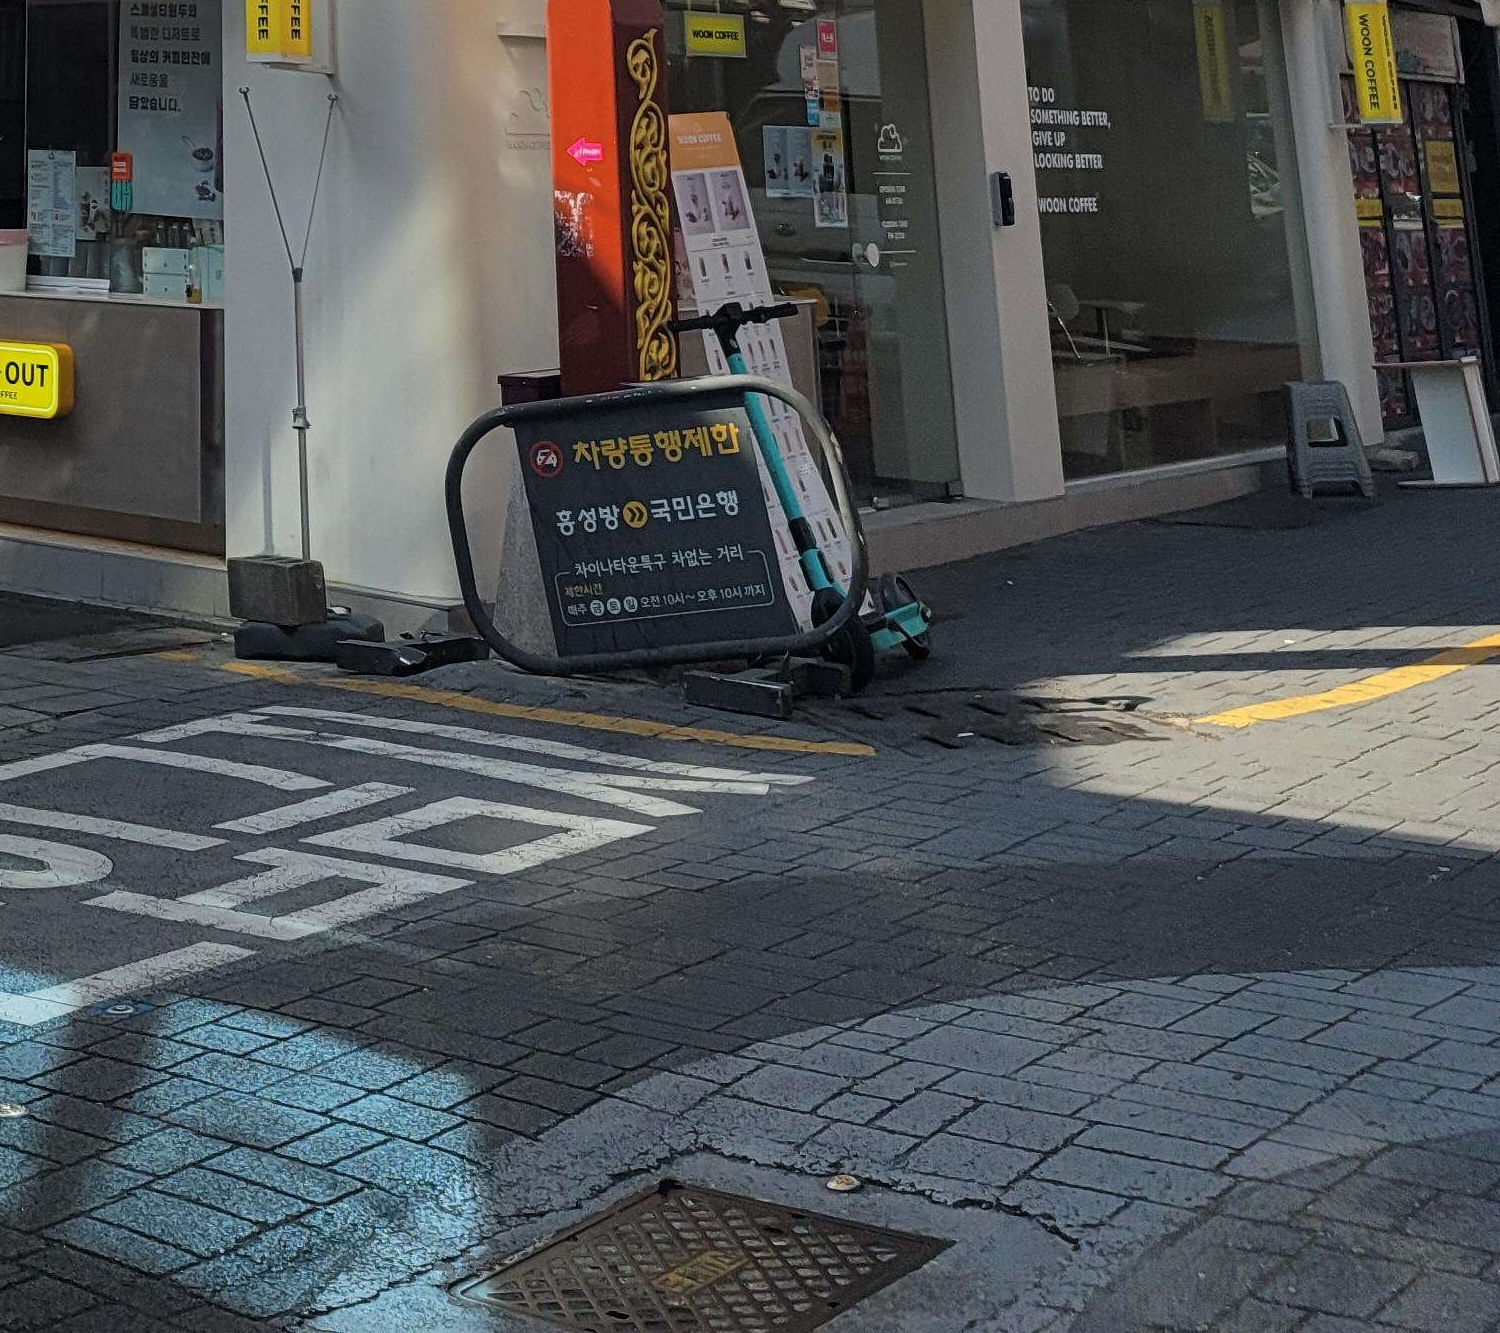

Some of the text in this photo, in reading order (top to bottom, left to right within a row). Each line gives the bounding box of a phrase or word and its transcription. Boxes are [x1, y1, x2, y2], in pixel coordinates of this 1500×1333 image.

[692, 29, 740, 42] WOON COFFEE
[1357, 13, 1380, 110] WOON COFFEE
[1028, 87, 1055, 103] TO DO
[1030, 109, 1111, 129] SOMETHING BETTER,
[1032, 130, 1066, 146] GIVE UP
[1034, 153, 1103, 170] LOOKING BETTER
[1037, 196, 1098, 214] WOON COFFEE
[572, 422, 740, 471] 차량통행제한
[555, 489, 740, 536] 홍성방 국민은행
[574, 543, 745, 579] 차이나타운특구 차없는 거리
[564, 582, 603, 598] 제한시간
[567, 603, 588, 617] 매주
[640, 594, 661, 608] 오전
[696, 588, 718, 603] 오후
[719, 584, 742, 600] 10시
[743, 583, 766, 597] 까지
